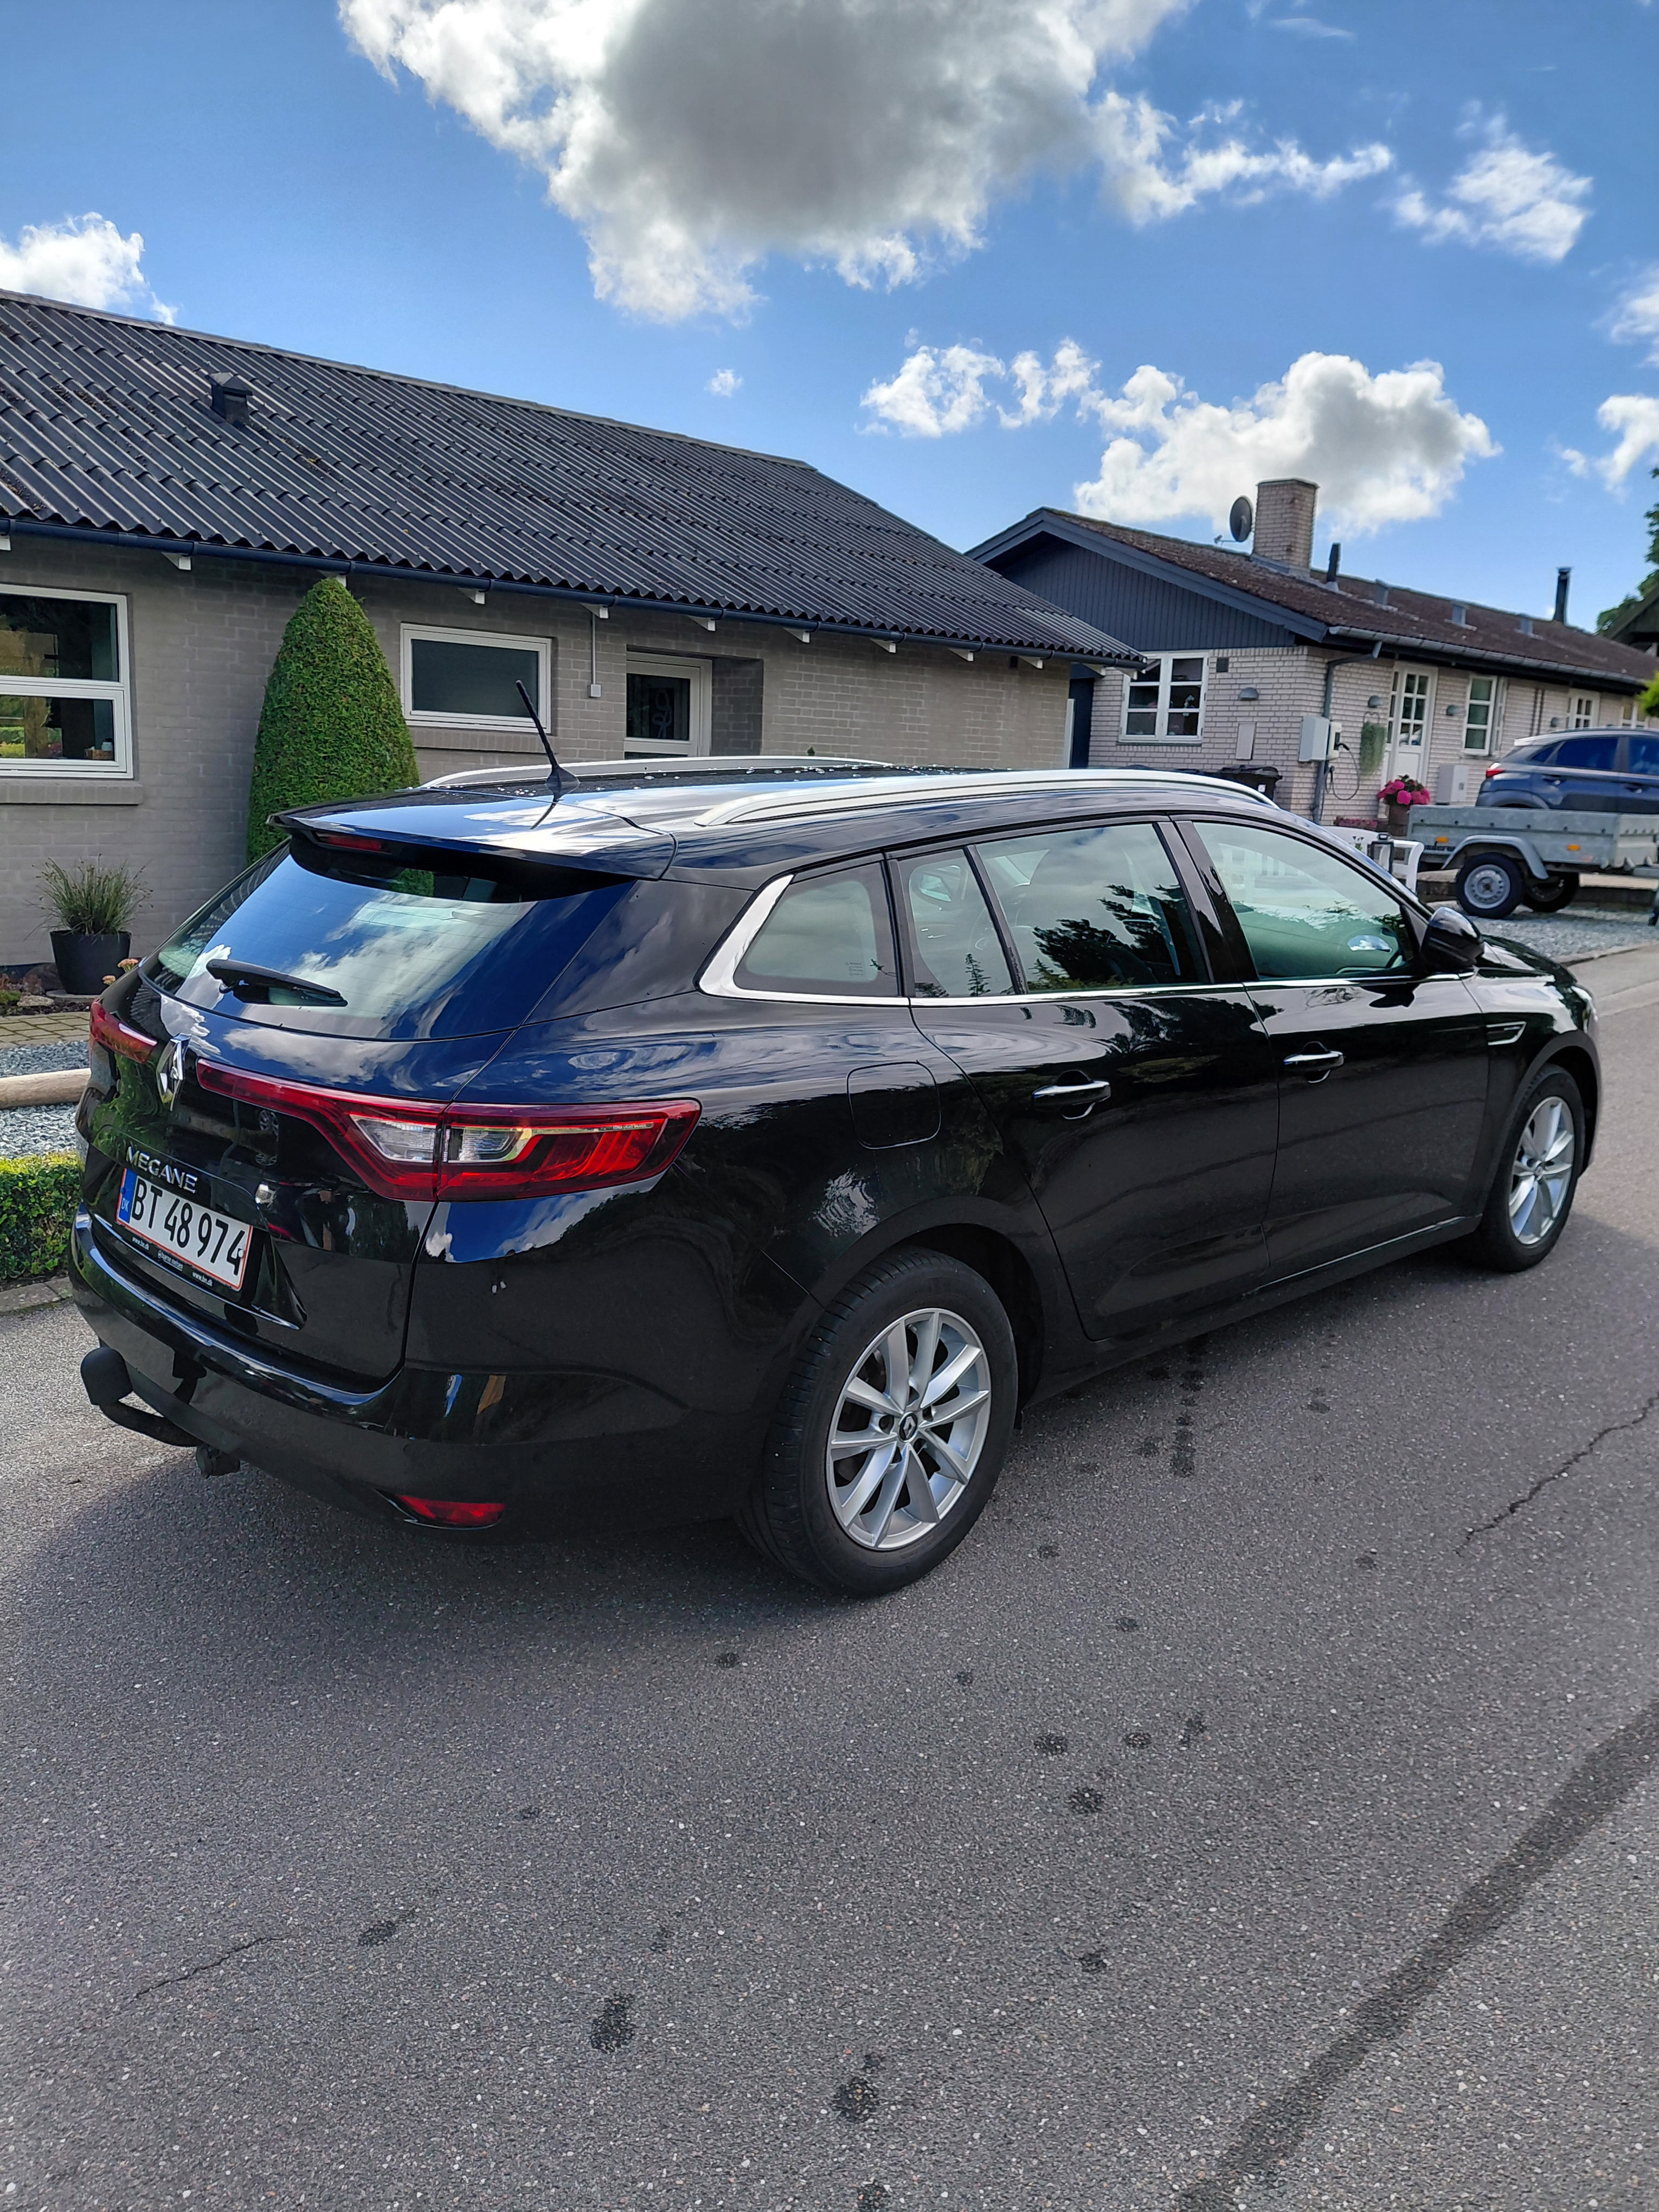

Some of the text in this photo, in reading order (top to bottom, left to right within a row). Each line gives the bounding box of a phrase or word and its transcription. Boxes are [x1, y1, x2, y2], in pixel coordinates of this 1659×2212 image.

[125, 1146, 198, 1194] MEGANE
[121, 1197, 130, 1212] DK
[131, 1178, 246, 1276] BT 48 974
[192, 1271, 214, 1288] www.bn.dk
